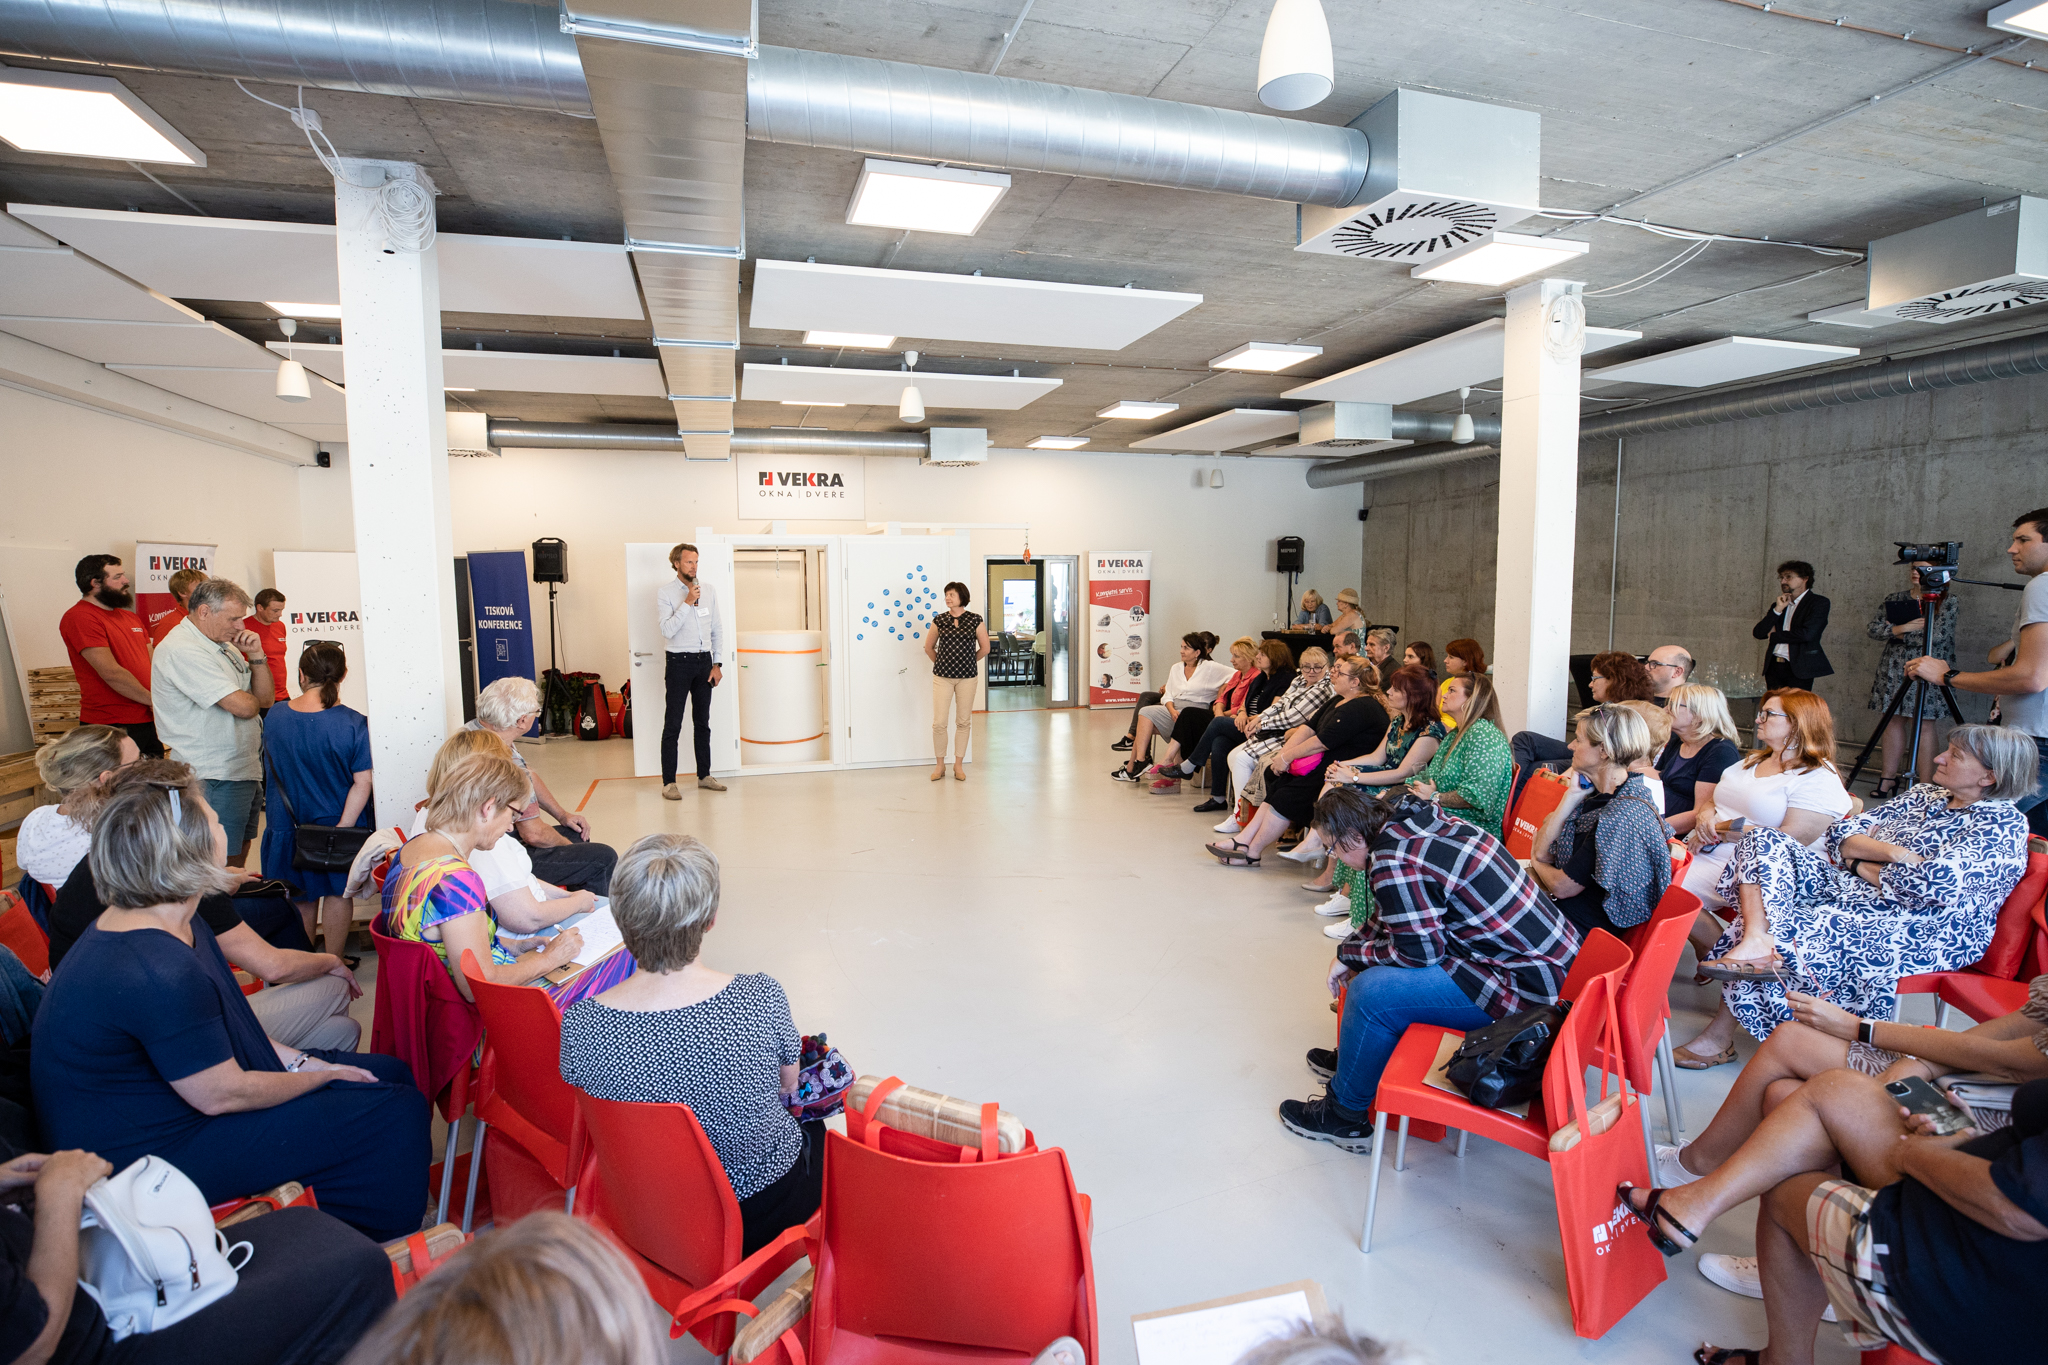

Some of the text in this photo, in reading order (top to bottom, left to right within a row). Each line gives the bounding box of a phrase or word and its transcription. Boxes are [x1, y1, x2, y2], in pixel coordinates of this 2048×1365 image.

[777, 472, 844, 487] VEKRA
[759, 490, 793, 498] OKNA
[162, 556, 207, 570] VEKRA
[1107, 559, 1143, 568] VEKRA
[484, 603, 515, 616] TISKOVÁ
[306, 611, 359, 623] VEKRA
[291, 626, 320, 634] OKNA
[478, 620, 523, 630] KONFERENCE
